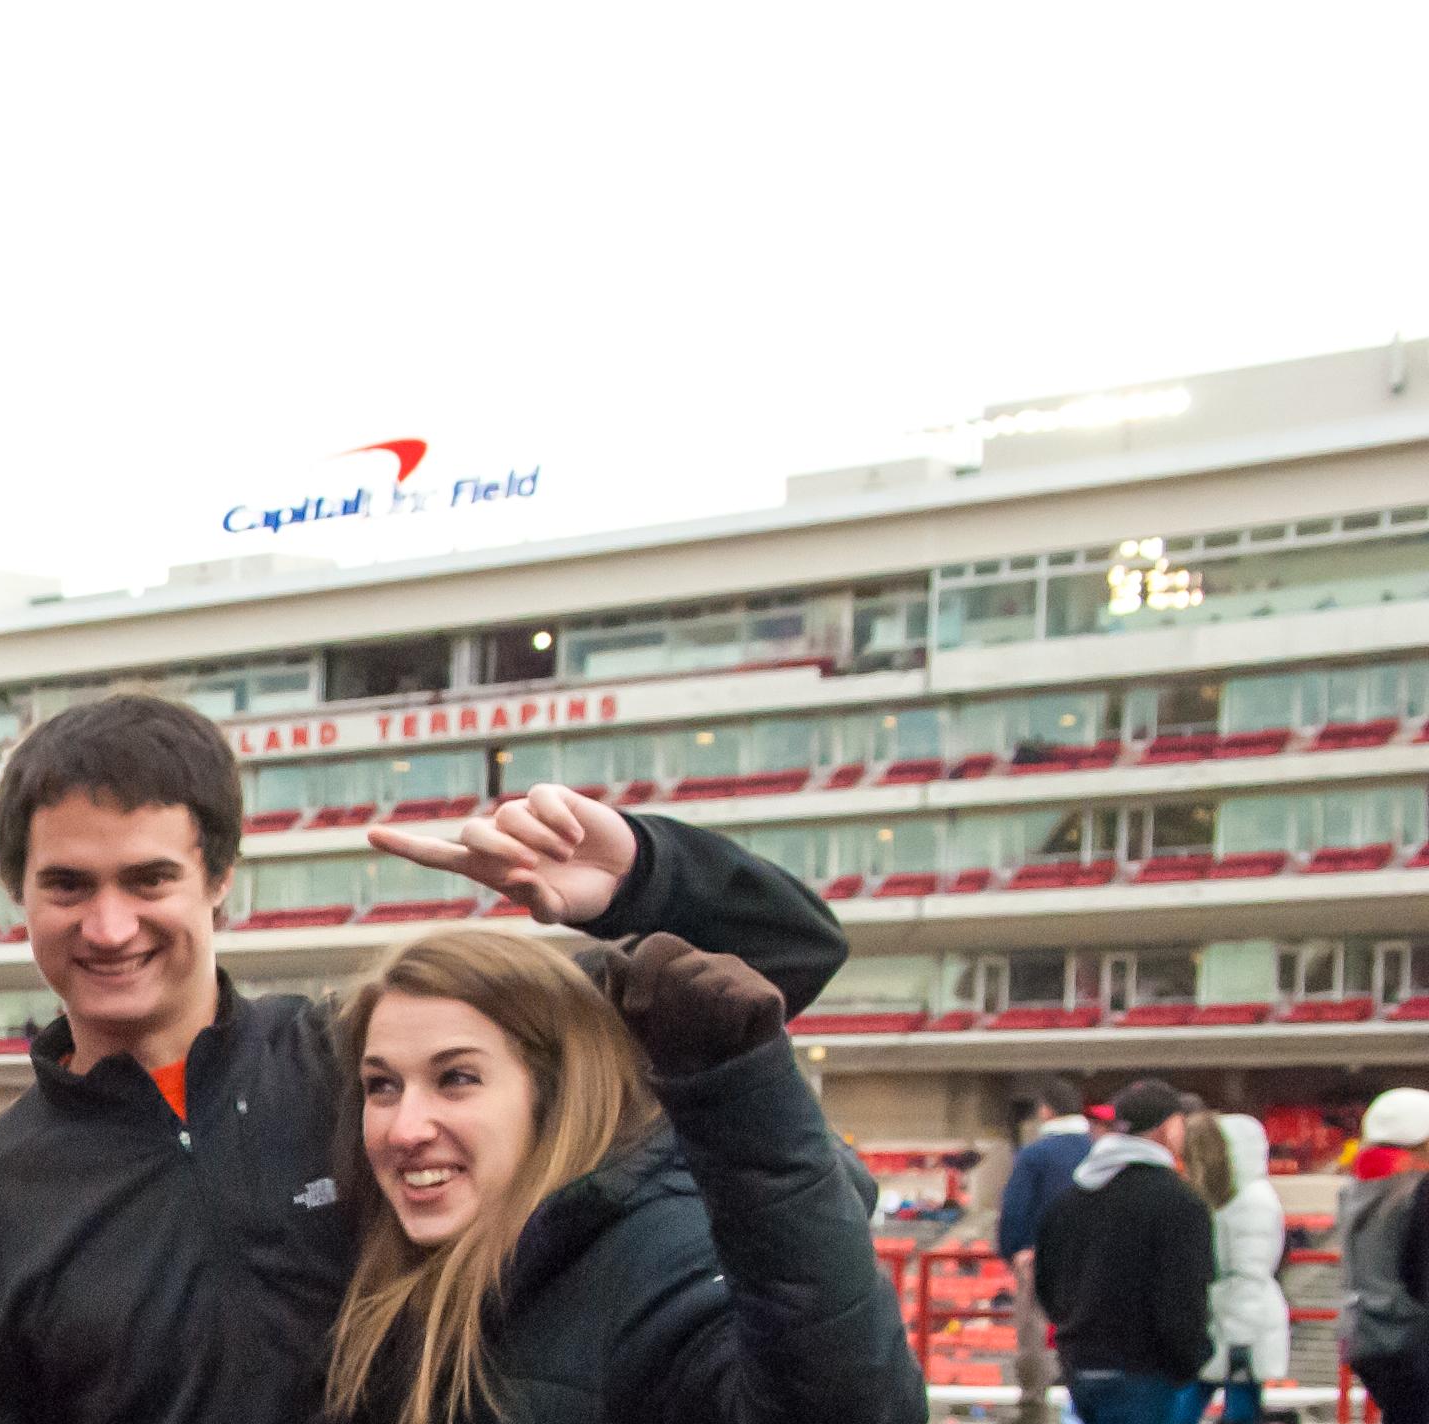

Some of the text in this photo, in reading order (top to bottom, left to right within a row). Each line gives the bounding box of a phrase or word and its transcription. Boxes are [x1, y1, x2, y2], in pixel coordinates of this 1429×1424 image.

[450, 464, 540, 506] Field
[237, 694, 617, 754] LAND TERRAPINS
